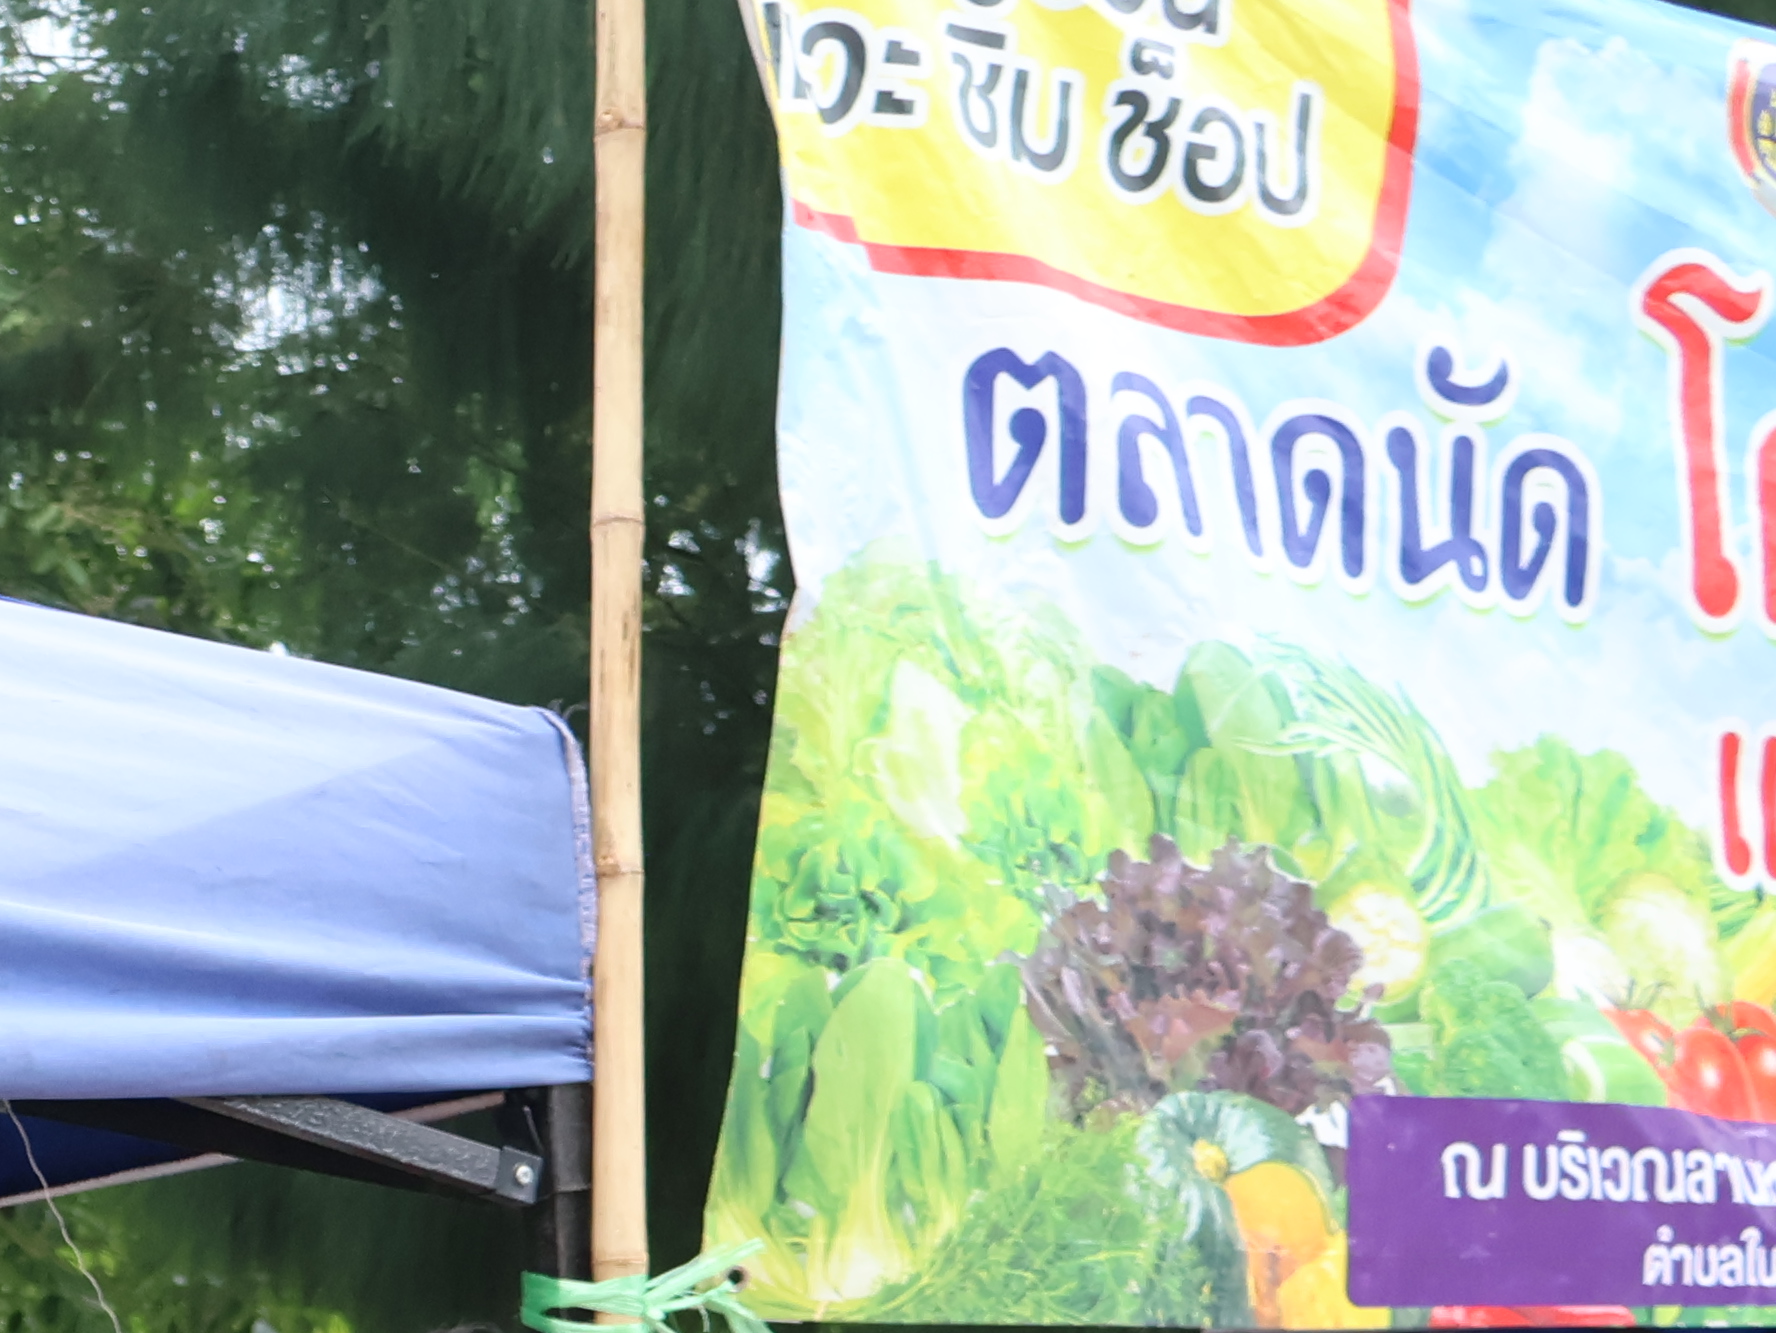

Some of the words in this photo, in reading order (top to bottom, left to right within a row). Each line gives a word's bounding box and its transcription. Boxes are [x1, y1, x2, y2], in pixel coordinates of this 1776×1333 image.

[945, 22, 1073, 173] ชิม
[1108, 38, 1313, 216] ช็อป
[963, 345, 1590, 608] ตลาดนัด
[1643, 263, 1776, 624] โ
[1441, 1141, 1509, 1201] ณ
